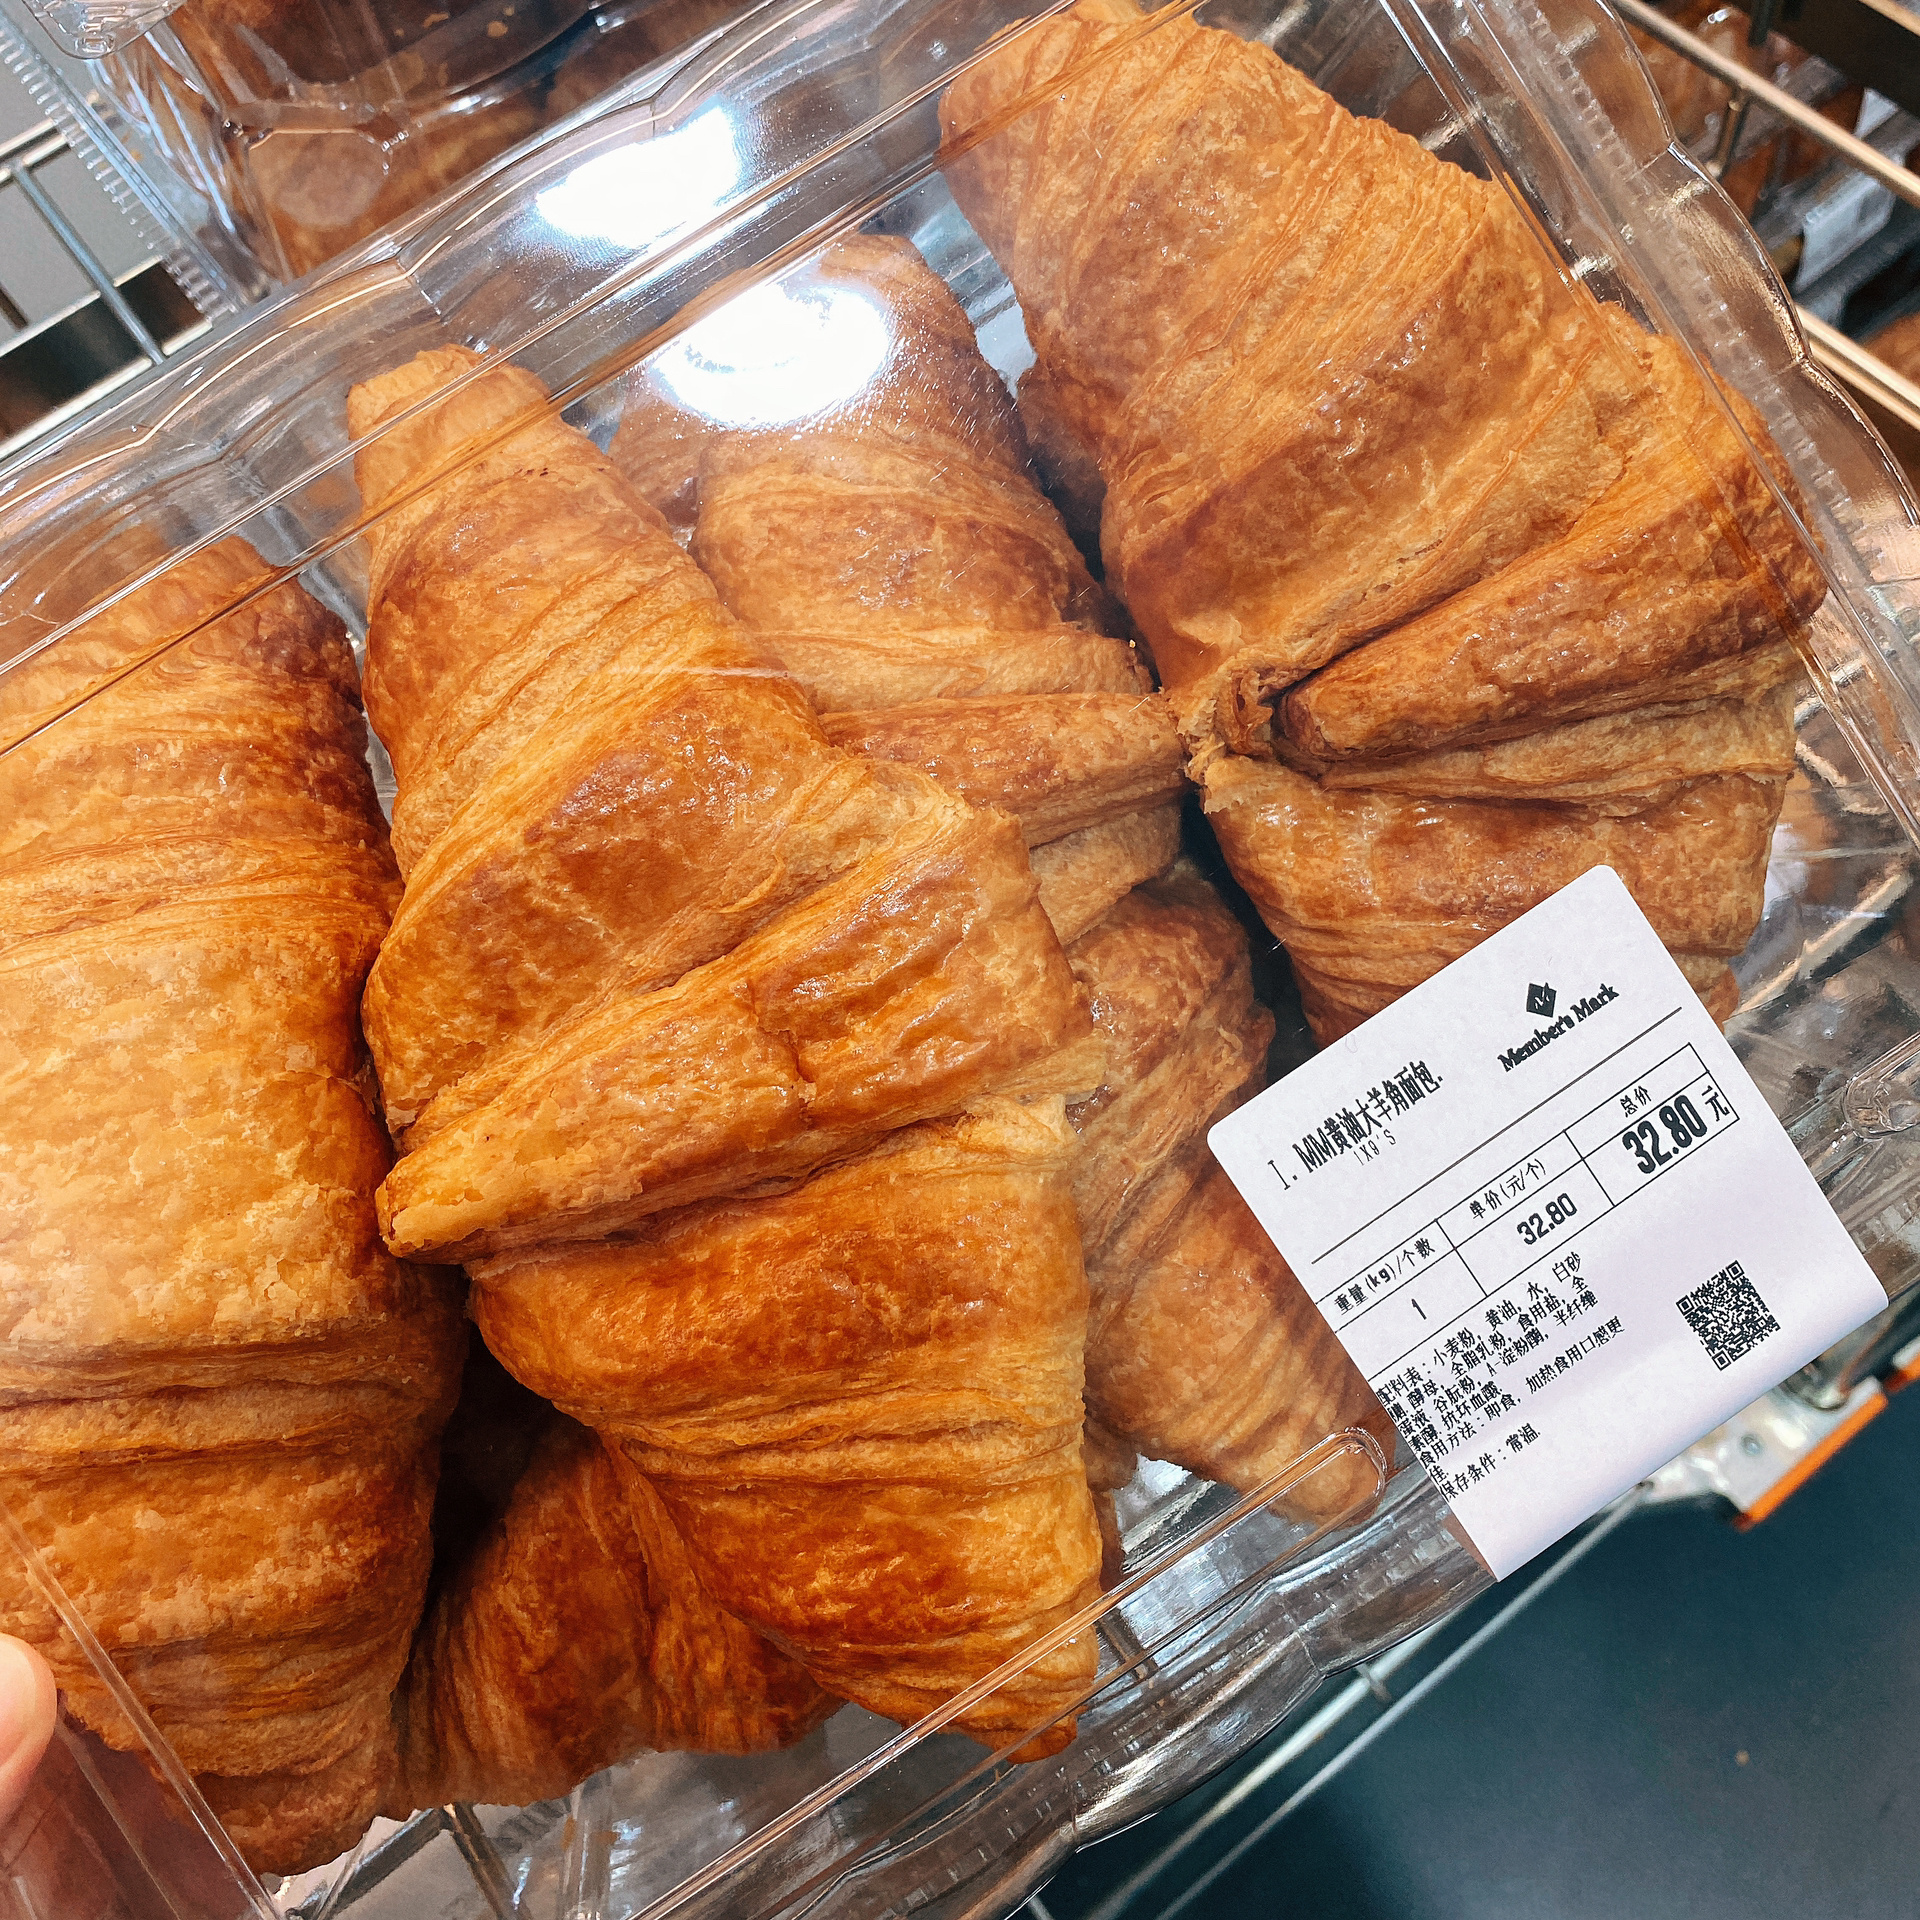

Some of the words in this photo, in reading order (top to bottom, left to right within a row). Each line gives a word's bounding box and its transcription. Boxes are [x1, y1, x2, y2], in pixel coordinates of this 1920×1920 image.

[1496, 1014, 1576, 1073] Member's
[1569, 983, 1620, 1023] Mark
[1619, 1085, 1652, 1118] 总价
[1621, 1094, 1708, 1175] 32.80
[1702, 1086, 1729, 1122] 元
[1516, 1192, 1578, 1246] 32.80
[1411, 1298, 1427, 1321] 1
